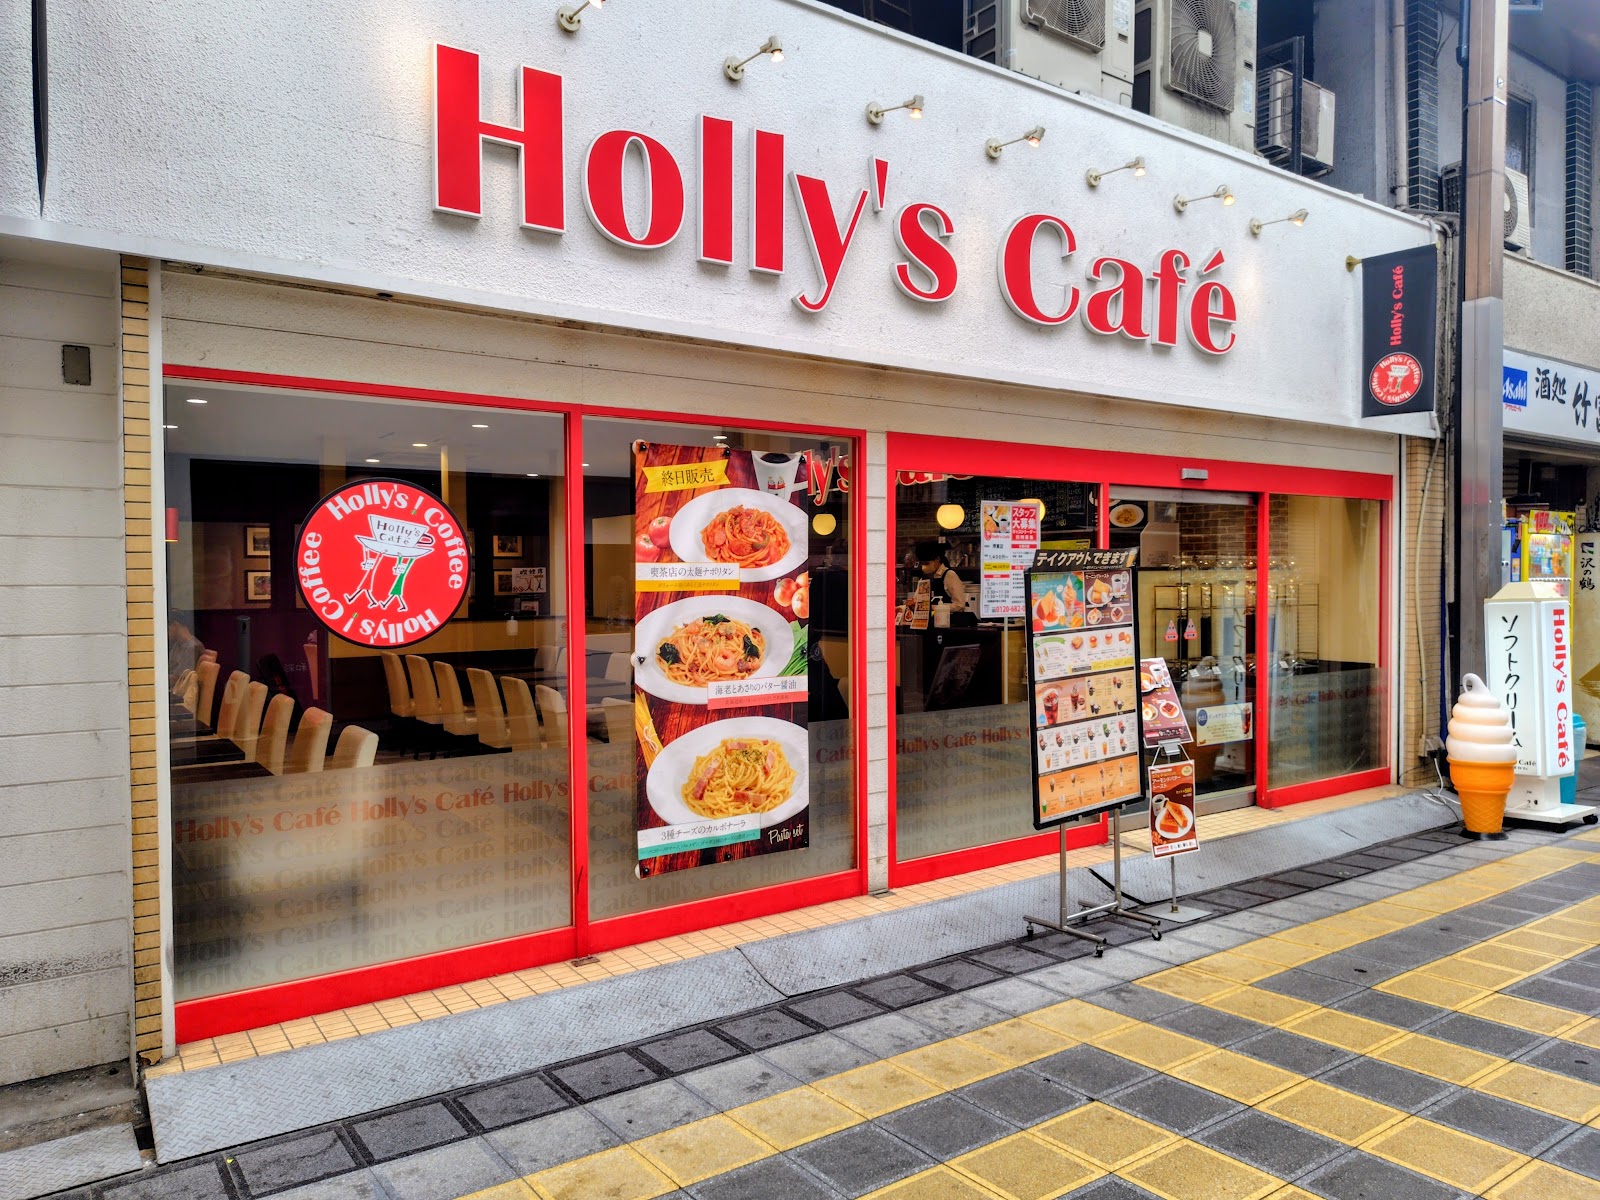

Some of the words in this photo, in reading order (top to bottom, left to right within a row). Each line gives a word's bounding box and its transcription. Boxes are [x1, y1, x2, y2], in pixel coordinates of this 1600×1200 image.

[433, 41, 958, 313] Holly's
[998, 212, 1237, 356] Café
[1392, 265, 1404, 300] Café
[1389, 302, 1405, 346] Holly's
[1407, 360, 1420, 384] Coffee
[1502, 376, 1526, 401] Asahi
[661, 468, 715, 486] 終日販売
[1012, 508, 1036, 518] スタッフ
[376, 519, 422, 538] Holly's
[424, 507, 466, 589] Coffee
[300, 531, 344, 620] Coffee
[650, 566, 734, 578] 喫茶店の太麺ナポリタン
[1579, 557, 1596, 591] 沢の鶴
[1553, 608, 1567, 694] Holly's
[715, 679, 797, 696] 海老とあさりのバター醤油
[896, 735, 939, 755] Holly's
[944, 730, 977, 749] Café
[982, 726, 1021, 744] Holly's
[1556, 701, 1570, 768] Café
[175, 813, 264, 844] Holly's
[273, 804, 342, 833] Café
[352, 795, 427, 823] Holly's
[436, 786, 495, 811] Café
[504, 779, 569, 804] Holly's
[661, 819, 747, 841] 3種チーズのカルボナーラ
[767, 829, 792, 845] Pasta
[792, 823, 804, 838] set
